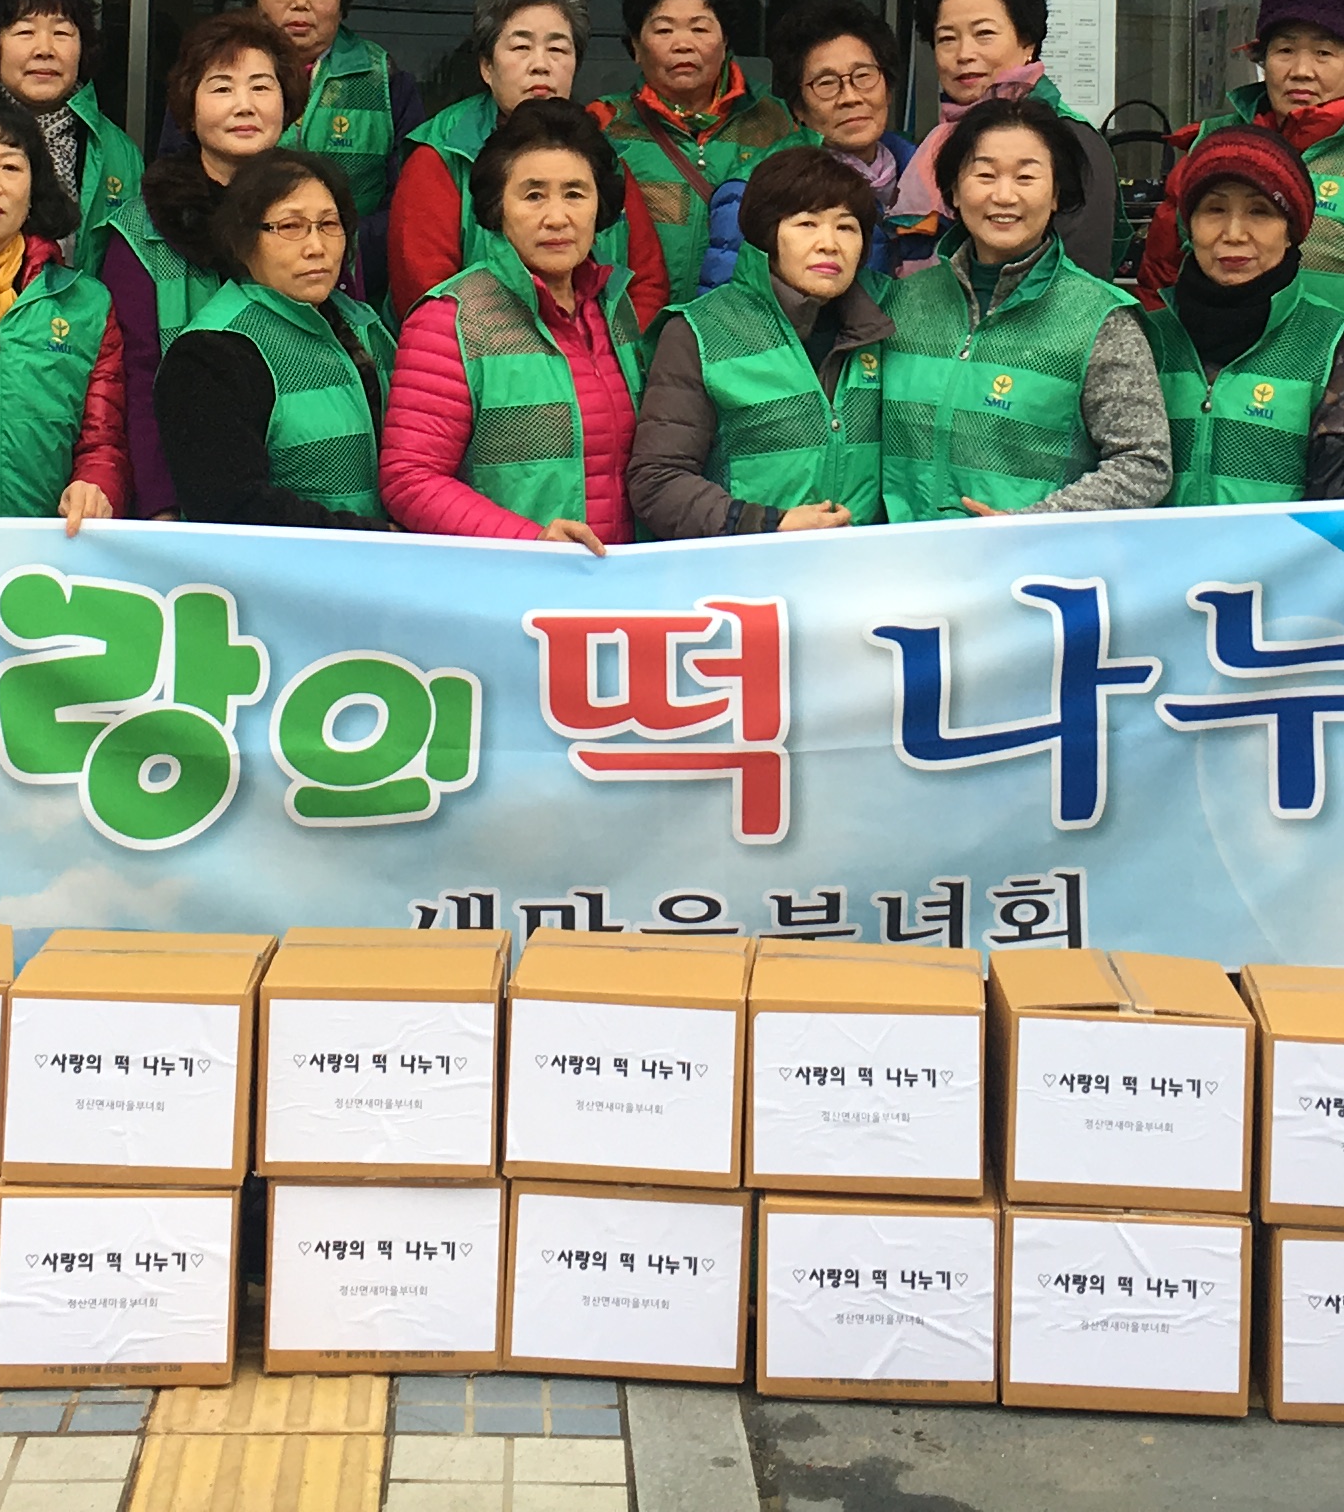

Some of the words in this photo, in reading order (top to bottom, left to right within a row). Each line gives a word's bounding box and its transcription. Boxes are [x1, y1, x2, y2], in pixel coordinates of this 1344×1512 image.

[330, 138, 353, 147] SMU
[985, 395, 1011, 412] SMU
[1245, 404, 1273, 420] SMU
[522, 595, 792, 843] 떡
[50, 1053, 102, 1075] 사랑의
[114, 1055, 130, 1075] 떡
[143, 1056, 194, 1078] 나누기
[309, 1053, 360, 1074] 사랑의
[372, 1053, 387, 1074] 떡
[400, 1054, 450, 1075] 나누기
[550, 1054, 601, 1076] 사랑의
[613, 1057, 629, 1078] 떡
[641, 1059, 691, 1082] 나누기
[794, 1066, 845, 1087] 사랑의
[858, 1067, 873, 1087] 떡
[886, 1067, 937, 1089] 나누기
[1058, 1073, 1110, 1095] 사랑의
[1122, 1075, 1138, 1096] 떡
[1150, 1077, 1201, 1099] 나누기
[41, 1252, 94, 1273] 사랑의
[106, 1252, 122, 1273] 떡
[135, 1252, 187, 1273] 나누기
[313, 1240, 365, 1261] 사랑의
[377, 1240, 393, 1261] 떡
[405, 1240, 456, 1262] 나누기
[556, 1249, 608, 1272] 사랑의
[619, 1252, 635, 1273] 떡
[647, 1254, 698, 1277] 나누기
[808, 1268, 860, 1289] 사랑의
[872, 1269, 887, 1290] 떡
[900, 1269, 951, 1291] 나누기
[1053, 1273, 1105, 1296] 사랑의
[1117, 1276, 1133, 1297] 떡
[1146, 1277, 1197, 1300] 나누기
